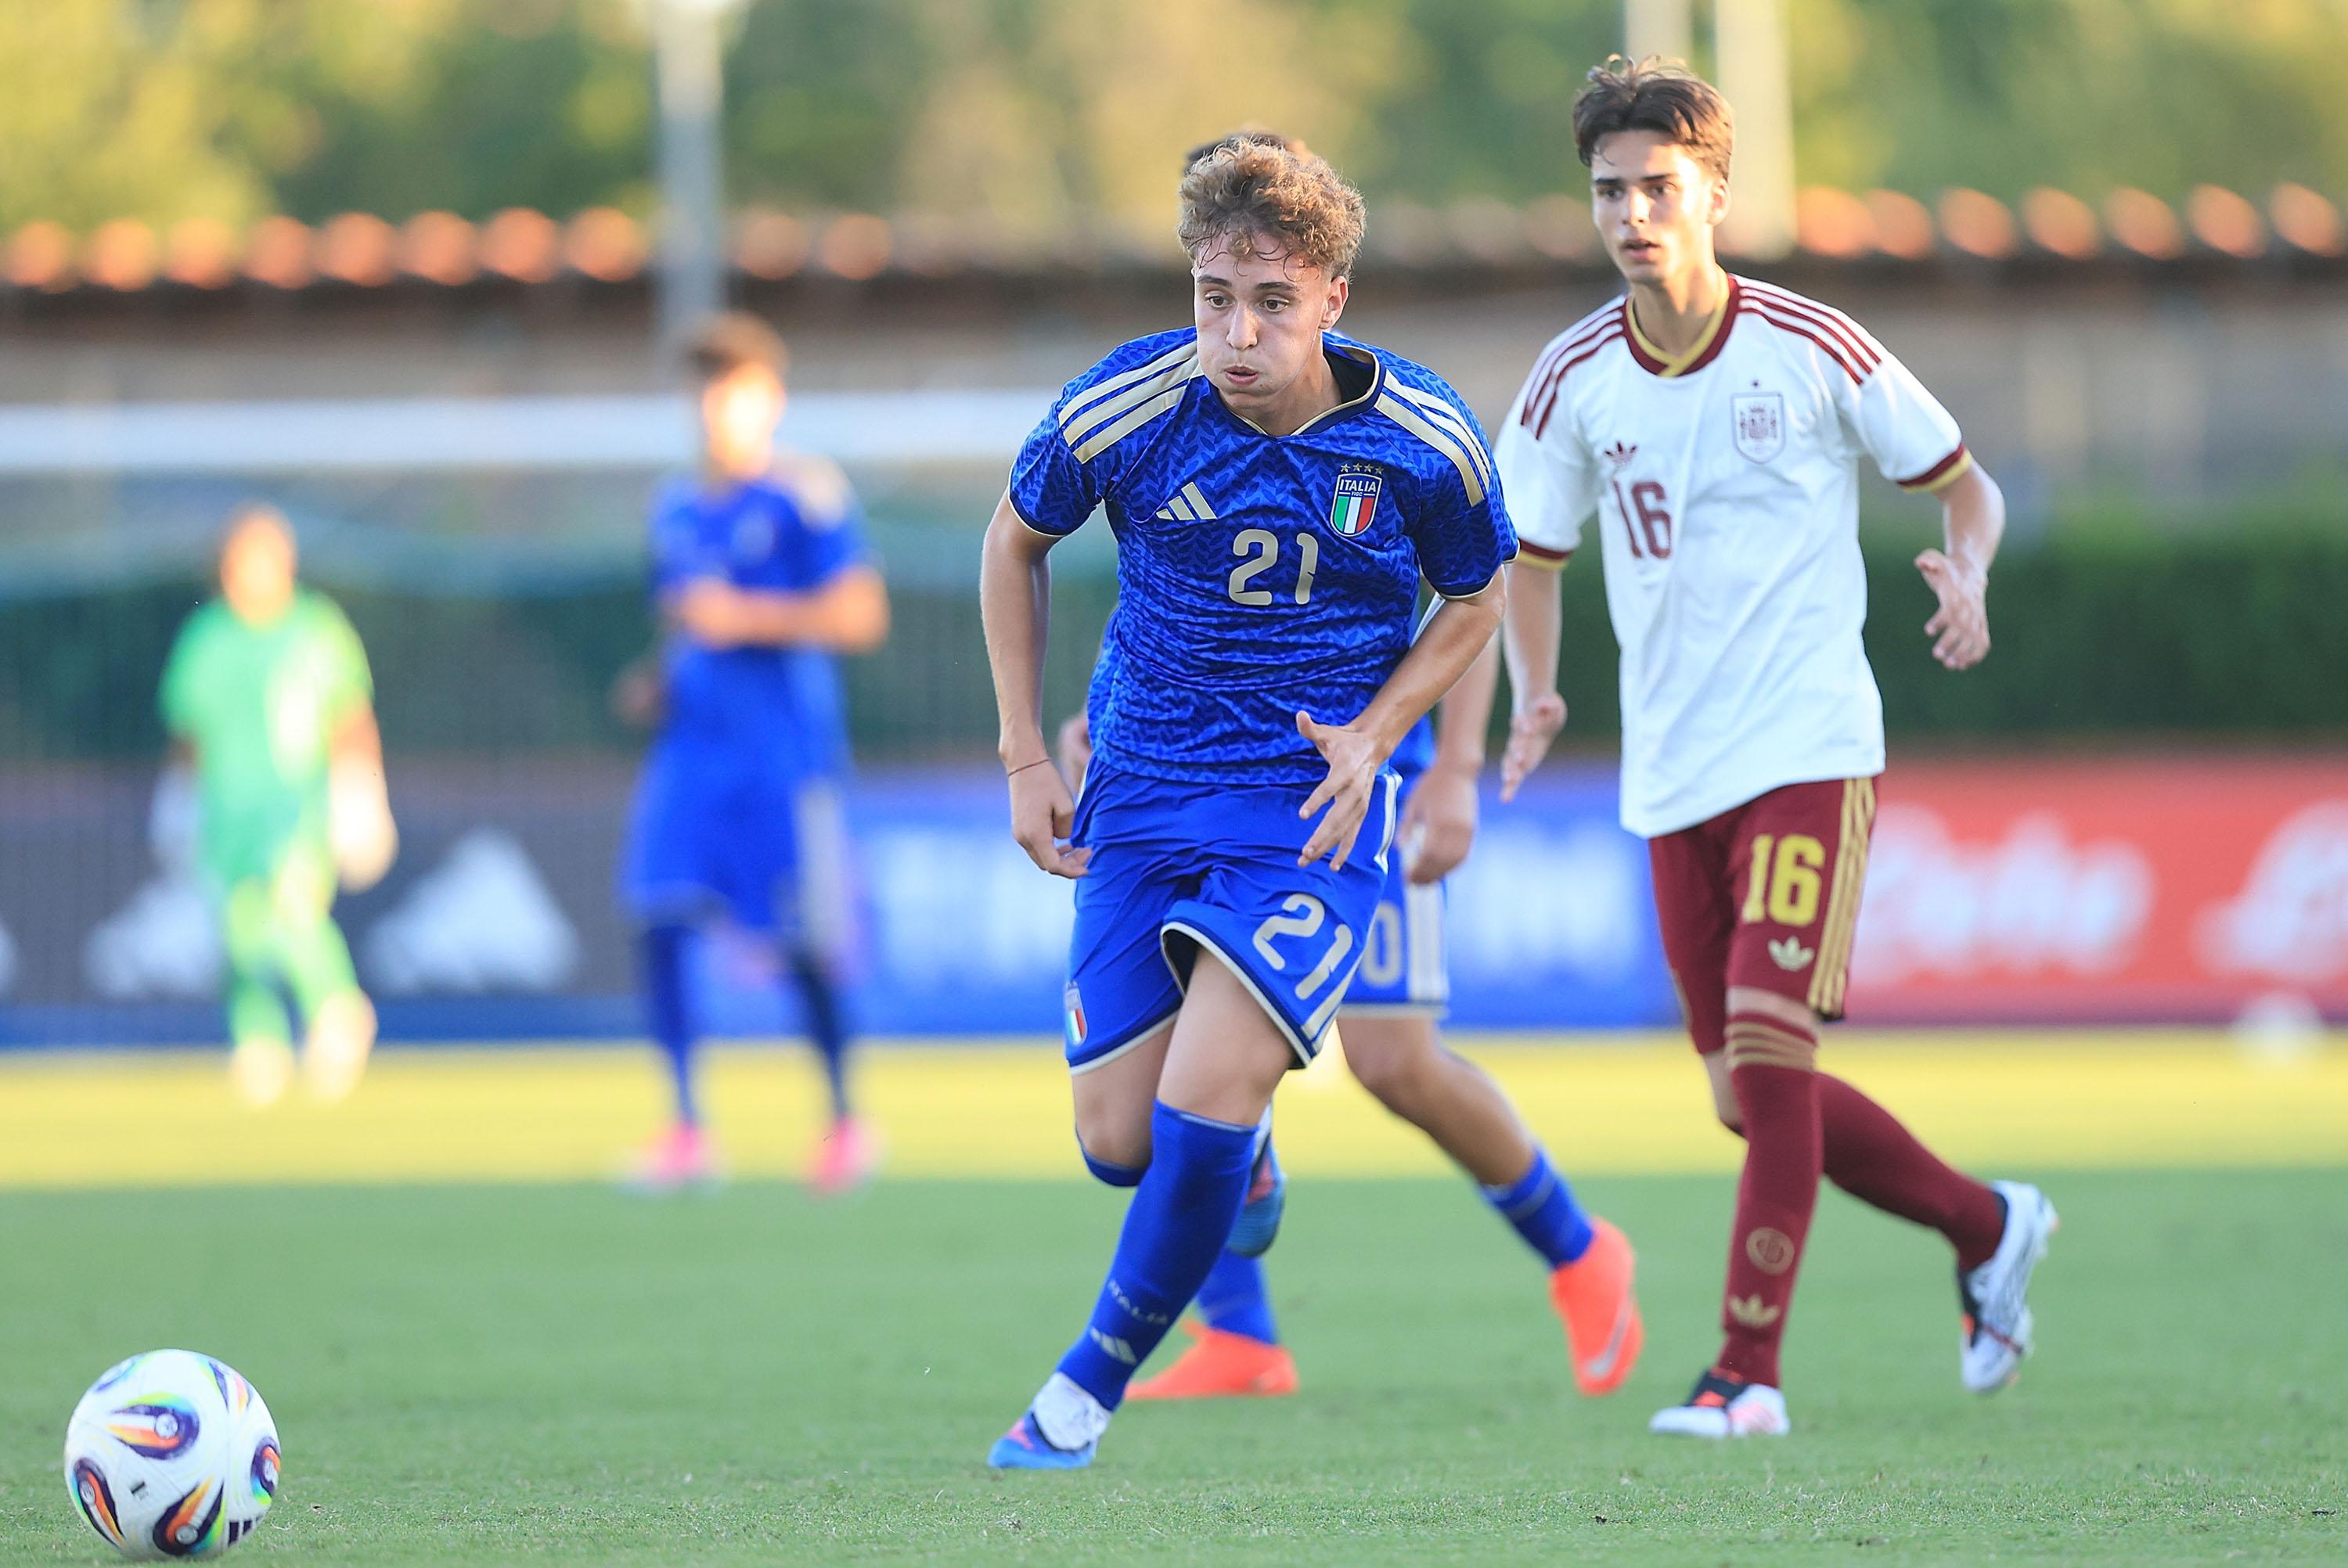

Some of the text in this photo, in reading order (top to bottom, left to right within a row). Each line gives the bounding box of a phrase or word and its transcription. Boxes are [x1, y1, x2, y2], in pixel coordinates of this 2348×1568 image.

[1339, 479, 1376, 492] ITALIA
[1612, 480, 1672, 560] 16
[1229, 529, 1319, 606] 21
[1741, 833, 1826, 929] 16
[1253, 893, 1353, 1000] 21
